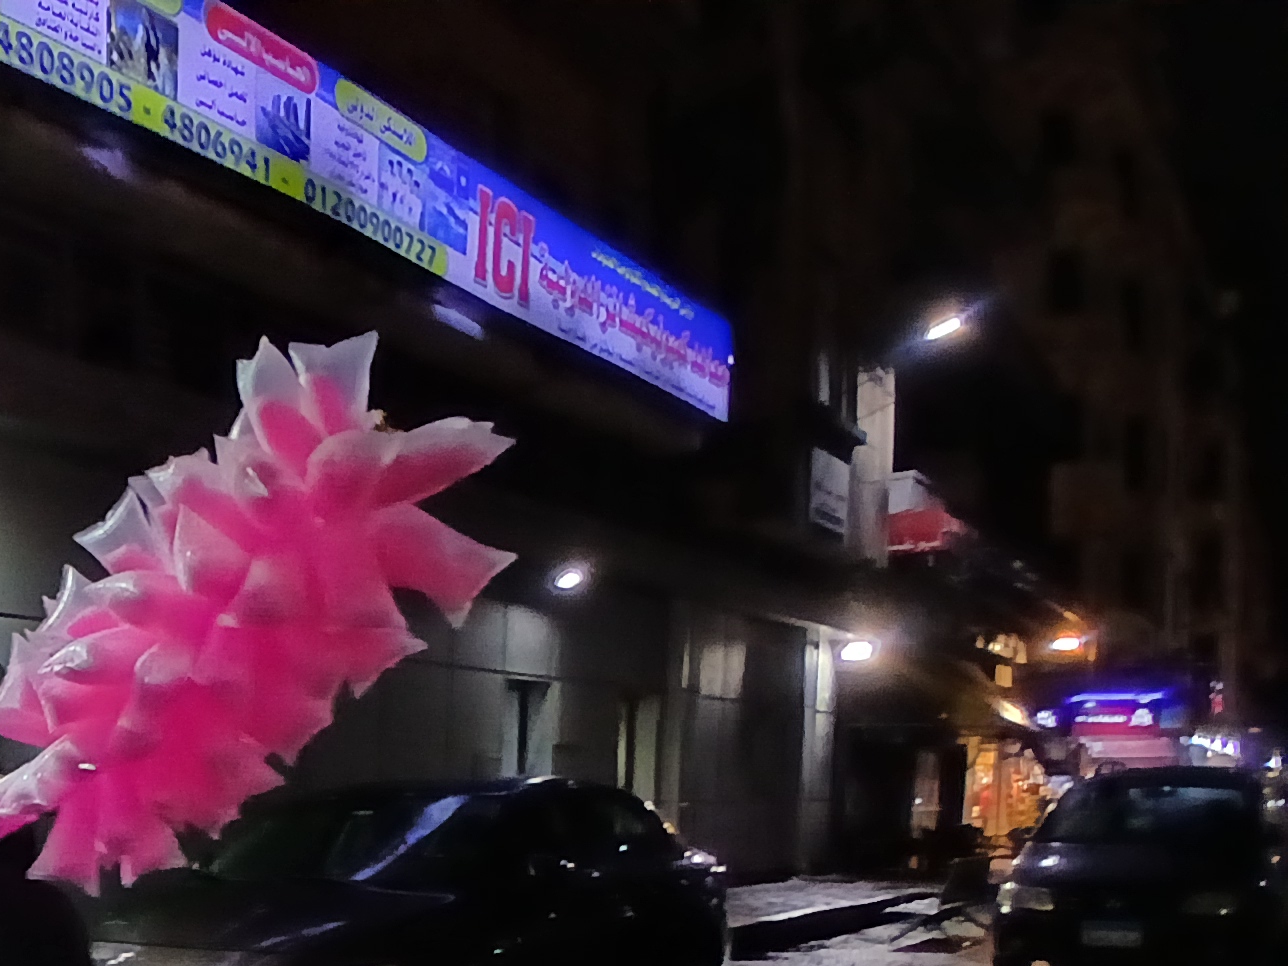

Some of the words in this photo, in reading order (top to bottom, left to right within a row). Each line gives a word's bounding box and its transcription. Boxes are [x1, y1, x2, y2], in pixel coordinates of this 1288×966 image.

[162, 104, 271, 184] 4806941
[303, 177, 438, 269] 01200900727
[474, 183, 536, 308] ICI
